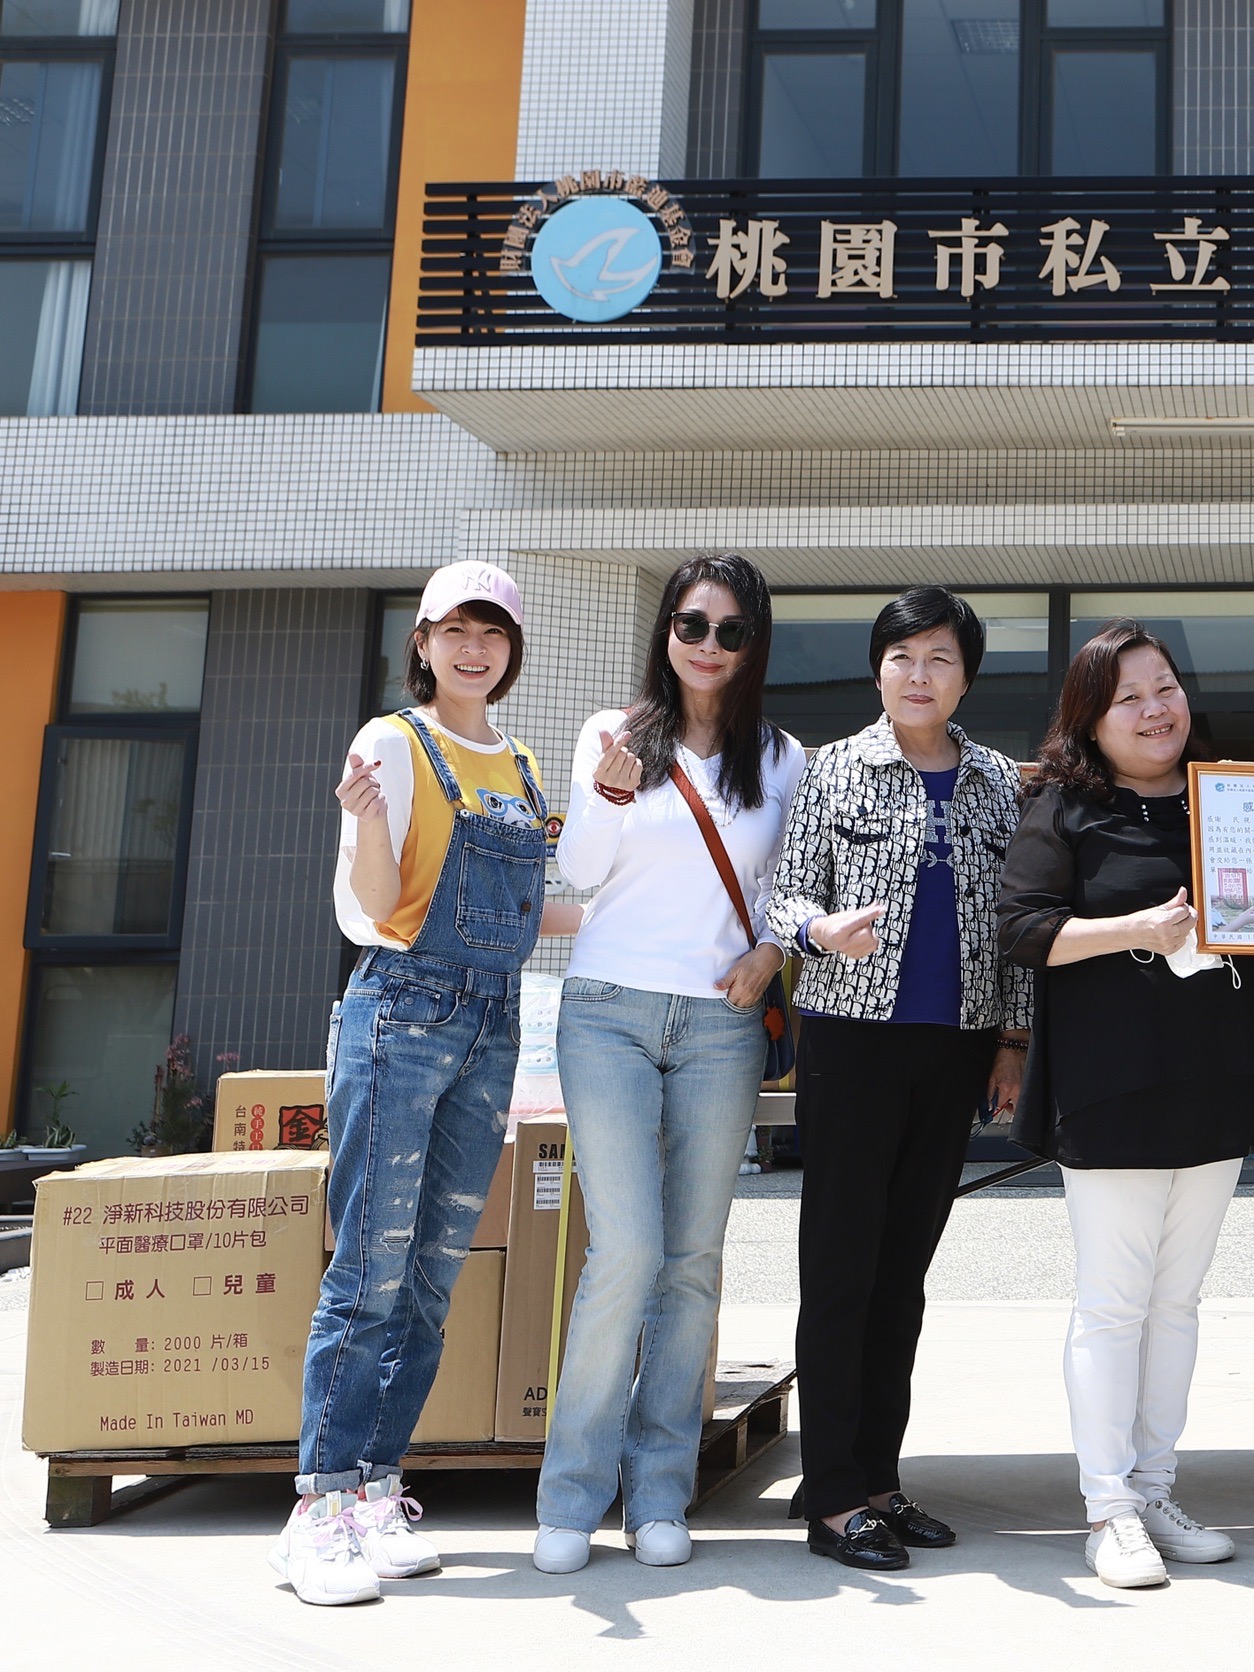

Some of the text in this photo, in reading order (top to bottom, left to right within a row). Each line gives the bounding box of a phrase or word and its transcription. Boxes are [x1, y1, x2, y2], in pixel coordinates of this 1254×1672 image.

[62, 1194, 309, 1226] #22 淨新科技股份有限公司
[98, 1230, 267, 1255] 平面醫療口罩/10片包
[114, 1272, 277, 1301] 成人 兒童
[164, 1335, 201, 1352] 2000
[210, 1332, 248, 1350] 片/箱
[90, 1359, 155, 1377] 製造日期:
[163, 1358, 201, 1373] 2021
[100, 1408, 254, 1432] Made In Taiwan MD
